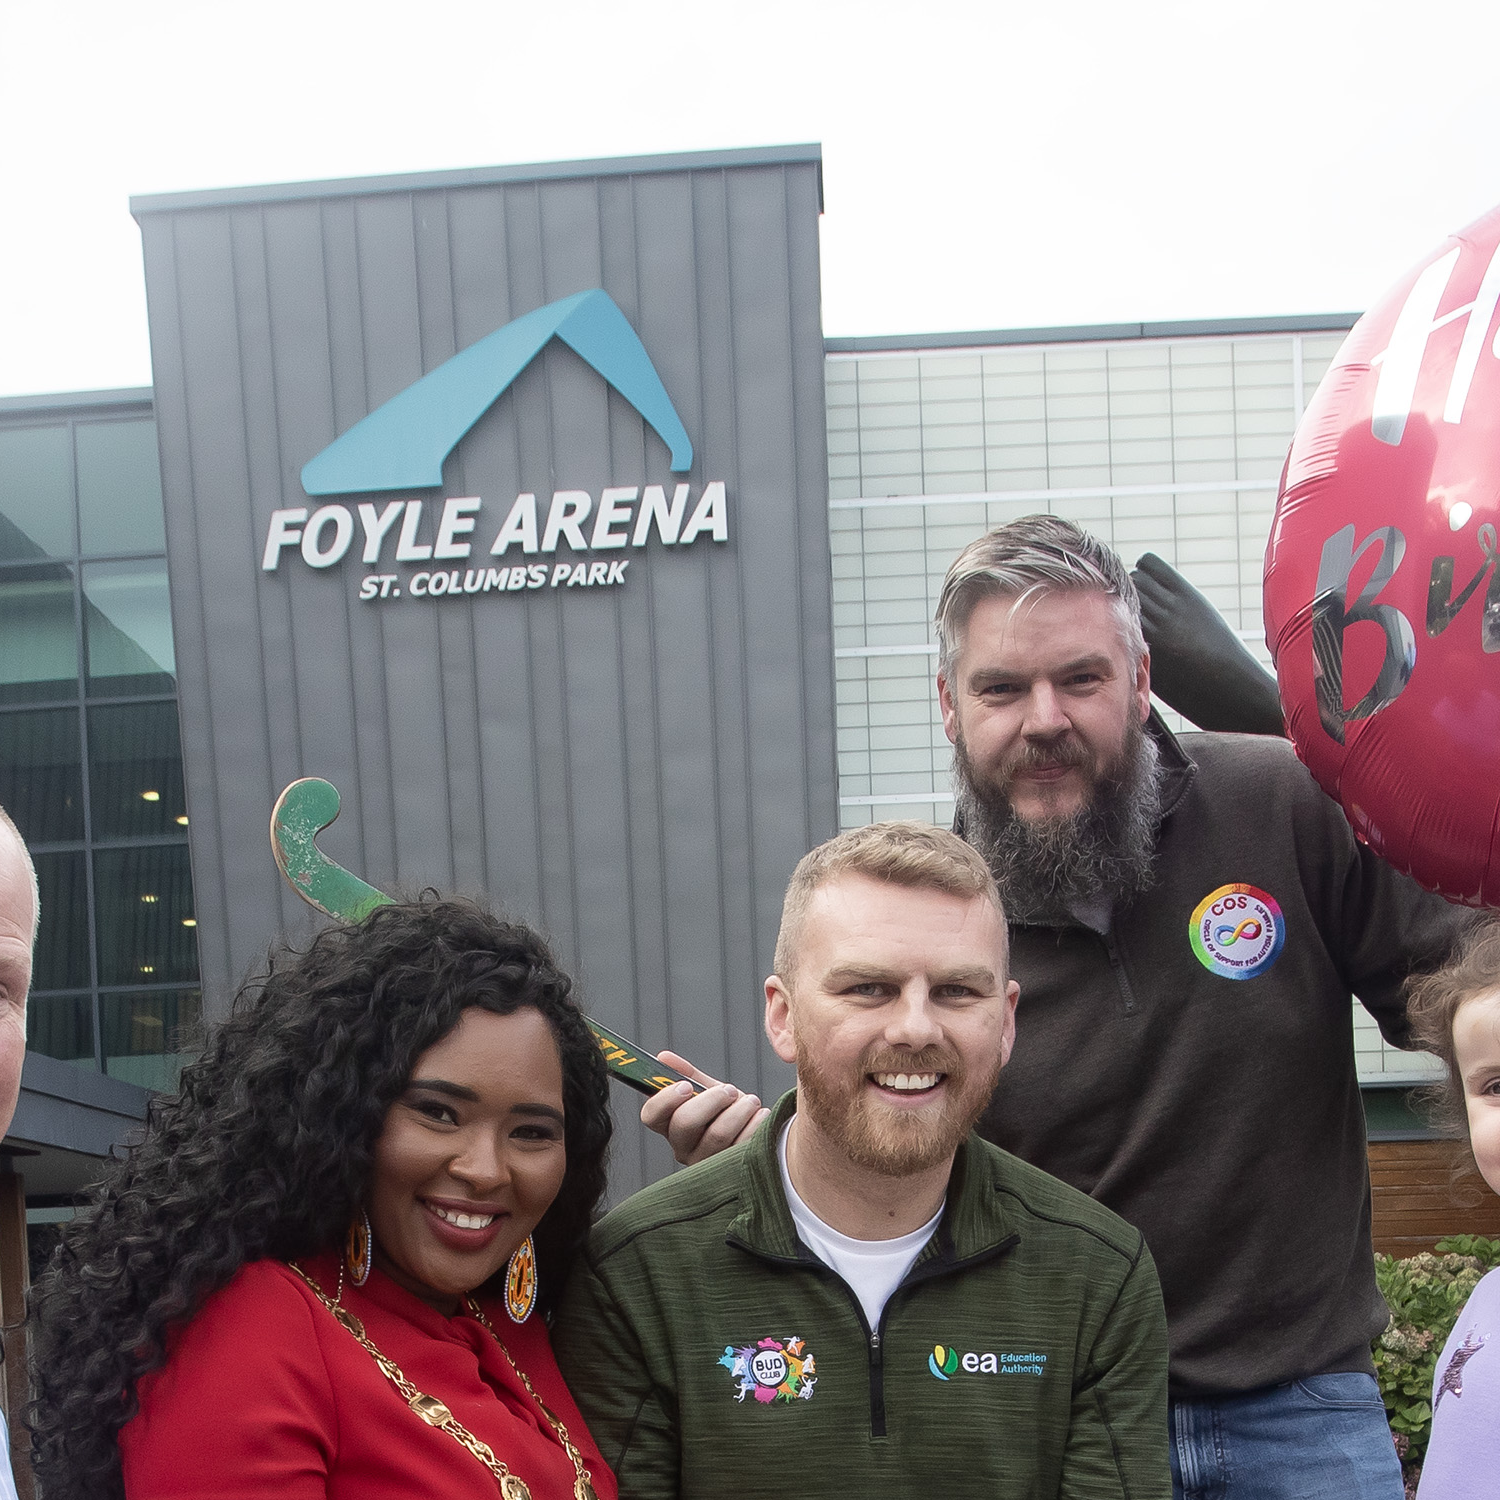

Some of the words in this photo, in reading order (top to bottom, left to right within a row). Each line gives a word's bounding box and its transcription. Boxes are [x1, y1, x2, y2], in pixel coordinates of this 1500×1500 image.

[262, 497, 481, 571] FOYLE
[490, 481, 729, 557] ARENA
[359, 574, 400, 600] ST.
[408, 563, 547, 597] COLUMB'S
[550, 560, 629, 588] PARK
[1211, 896, 1248, 916] COS
[1207, 943, 1216, 952] OF
[1214, 952, 1244, 967] SUPPORT
[1257, 935, 1273, 960] AUTISM
[755, 1358, 782, 1371] BUD
[961, 1352, 998, 1374] ea
[1000, 1353, 1047, 1363] Education
[760, 1371, 781, 1379] CLUB
[1001, 1364, 1044, 1376] Authority
